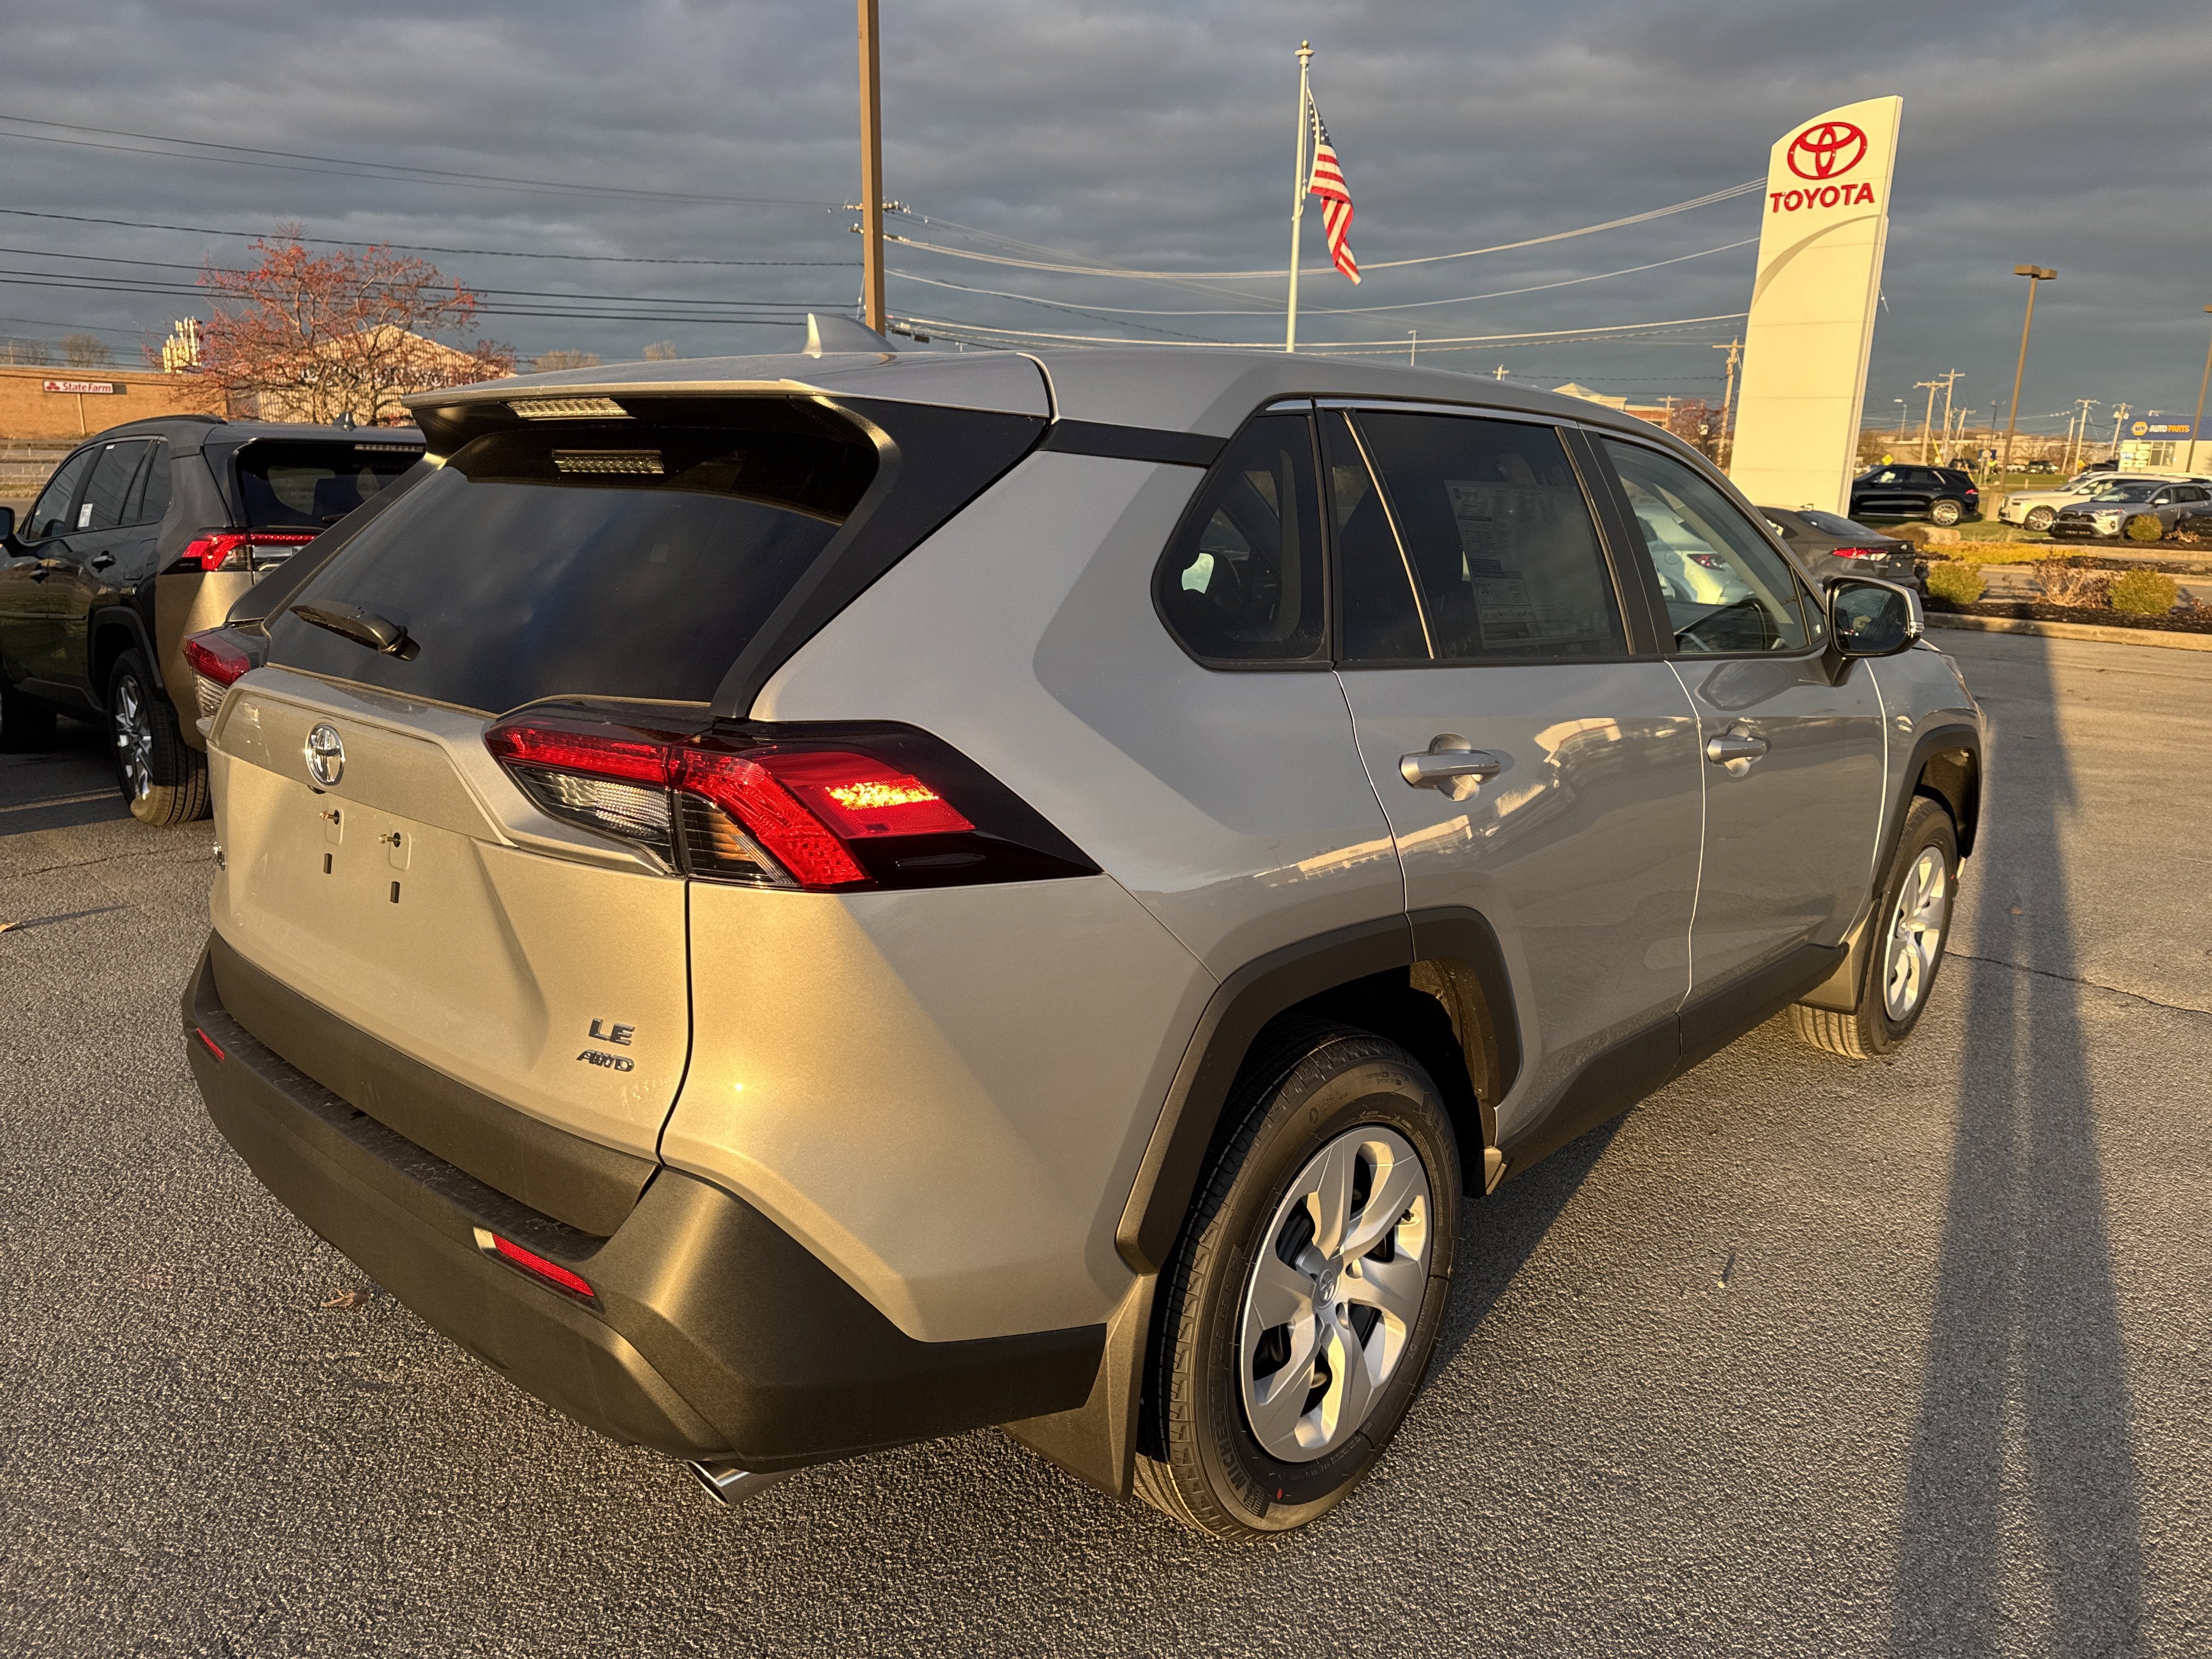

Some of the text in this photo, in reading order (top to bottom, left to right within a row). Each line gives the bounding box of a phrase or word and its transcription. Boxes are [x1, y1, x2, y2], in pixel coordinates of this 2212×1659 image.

[1770, 182, 1876, 213] TOYOTA
[2149, 425, 2168, 433] AUTO
[2168, 425, 2190, 433] PARTS
[588, 1018, 636, 1046] LE
[575, 1048, 635, 1073] AWD
[1211, 1258, 1240, 1362] 225/65 R 17
[1211, 1386, 1246, 1491] MICHELIN
